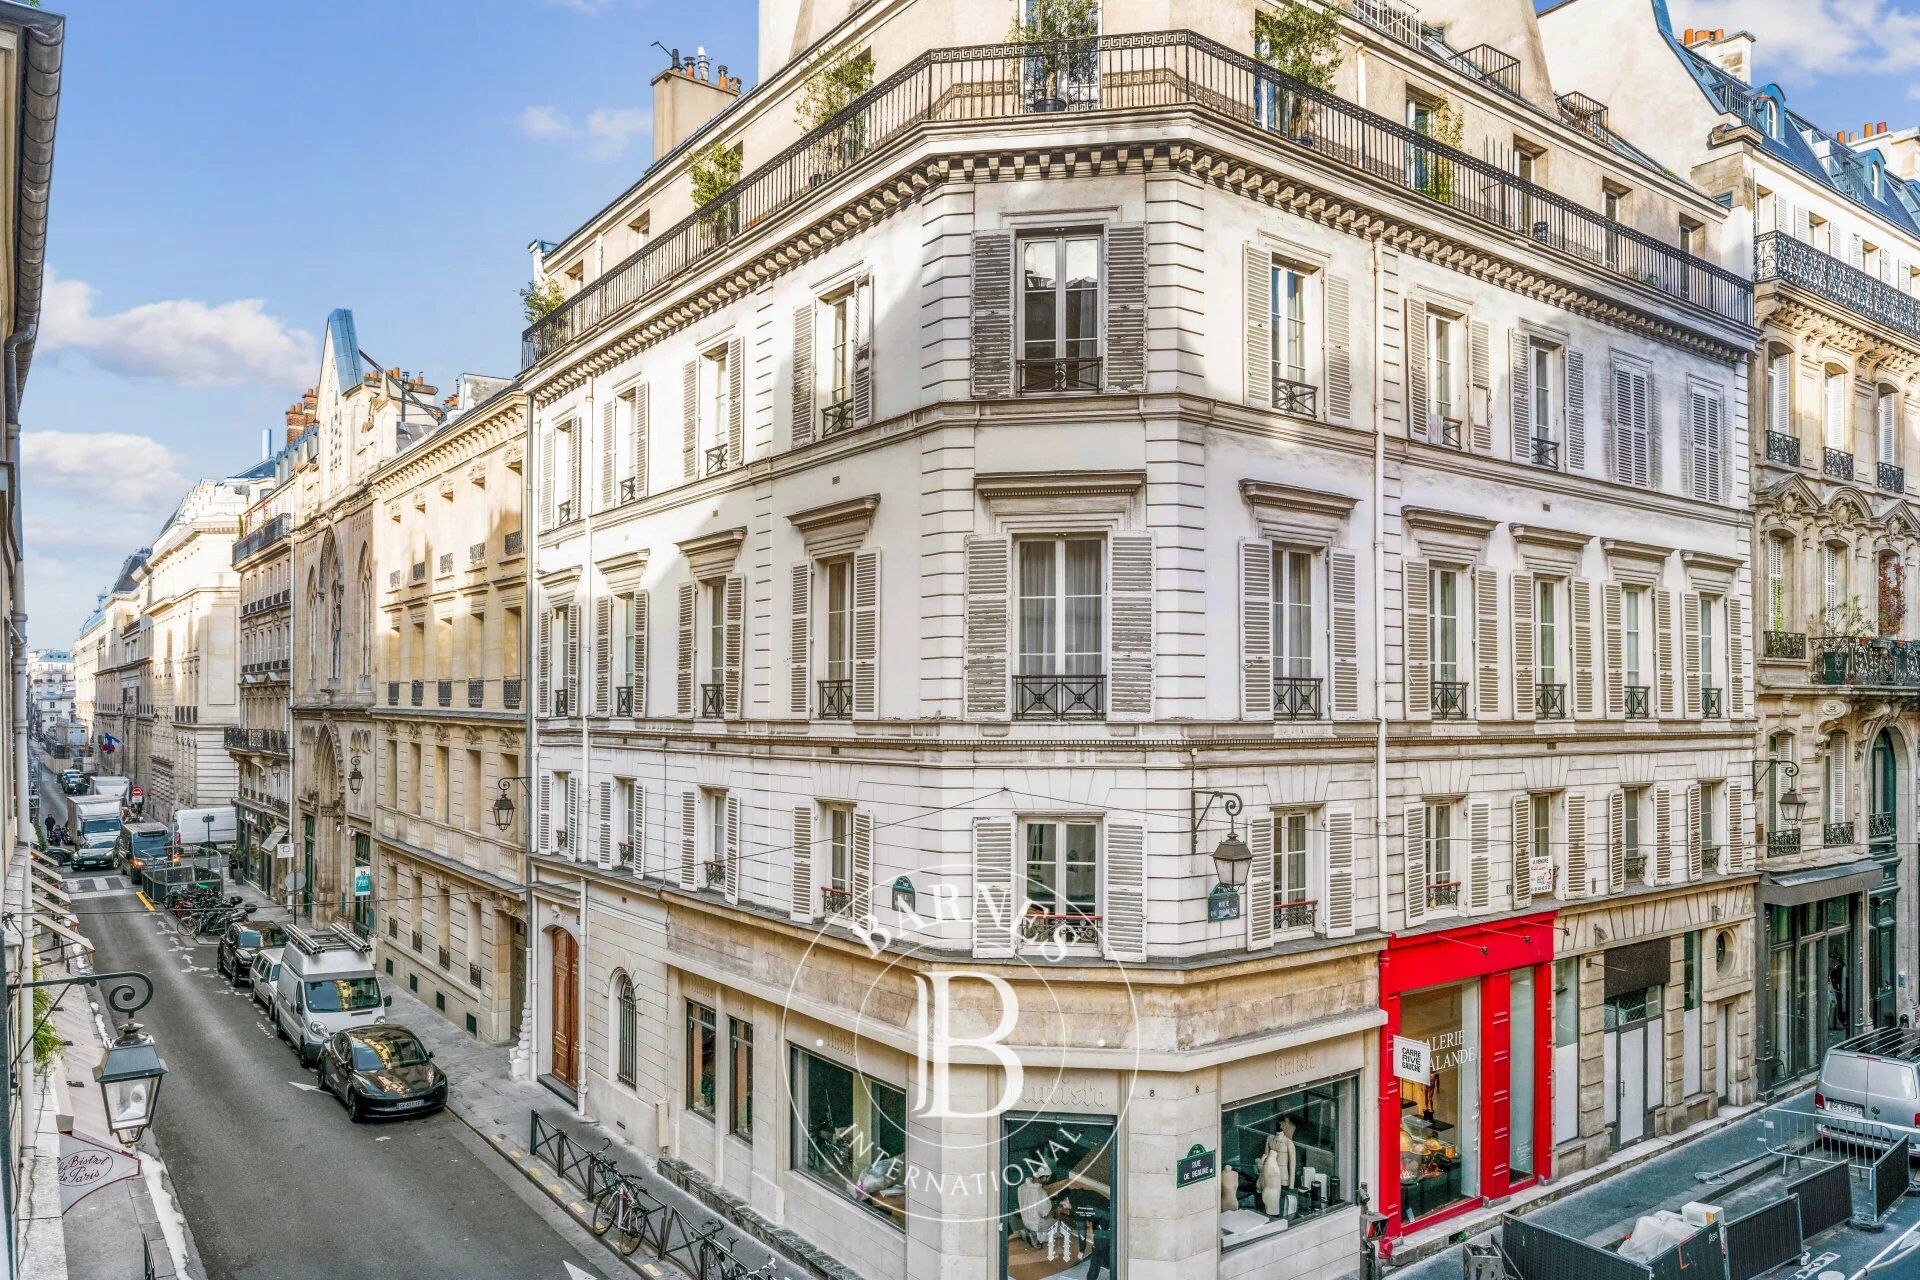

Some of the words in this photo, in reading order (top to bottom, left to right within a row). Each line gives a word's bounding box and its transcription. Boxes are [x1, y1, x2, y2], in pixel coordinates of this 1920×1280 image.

[1421, 1029, 1465, 1052] ALERIE
[1402, 1055, 1421, 1066] RIVE
[1430, 1046, 1476, 1072] ALANDE
[1401, 1062, 1421, 1073] GAUCHE
[1149, 1089, 1155, 1098] 8
[1191, 1159, 1202, 1169] RUE
[67, 1166, 100, 1184] Paris
[1183, 1171, 1190, 1181] DE
[1191, 1166, 1209, 1178] BEAUNE
